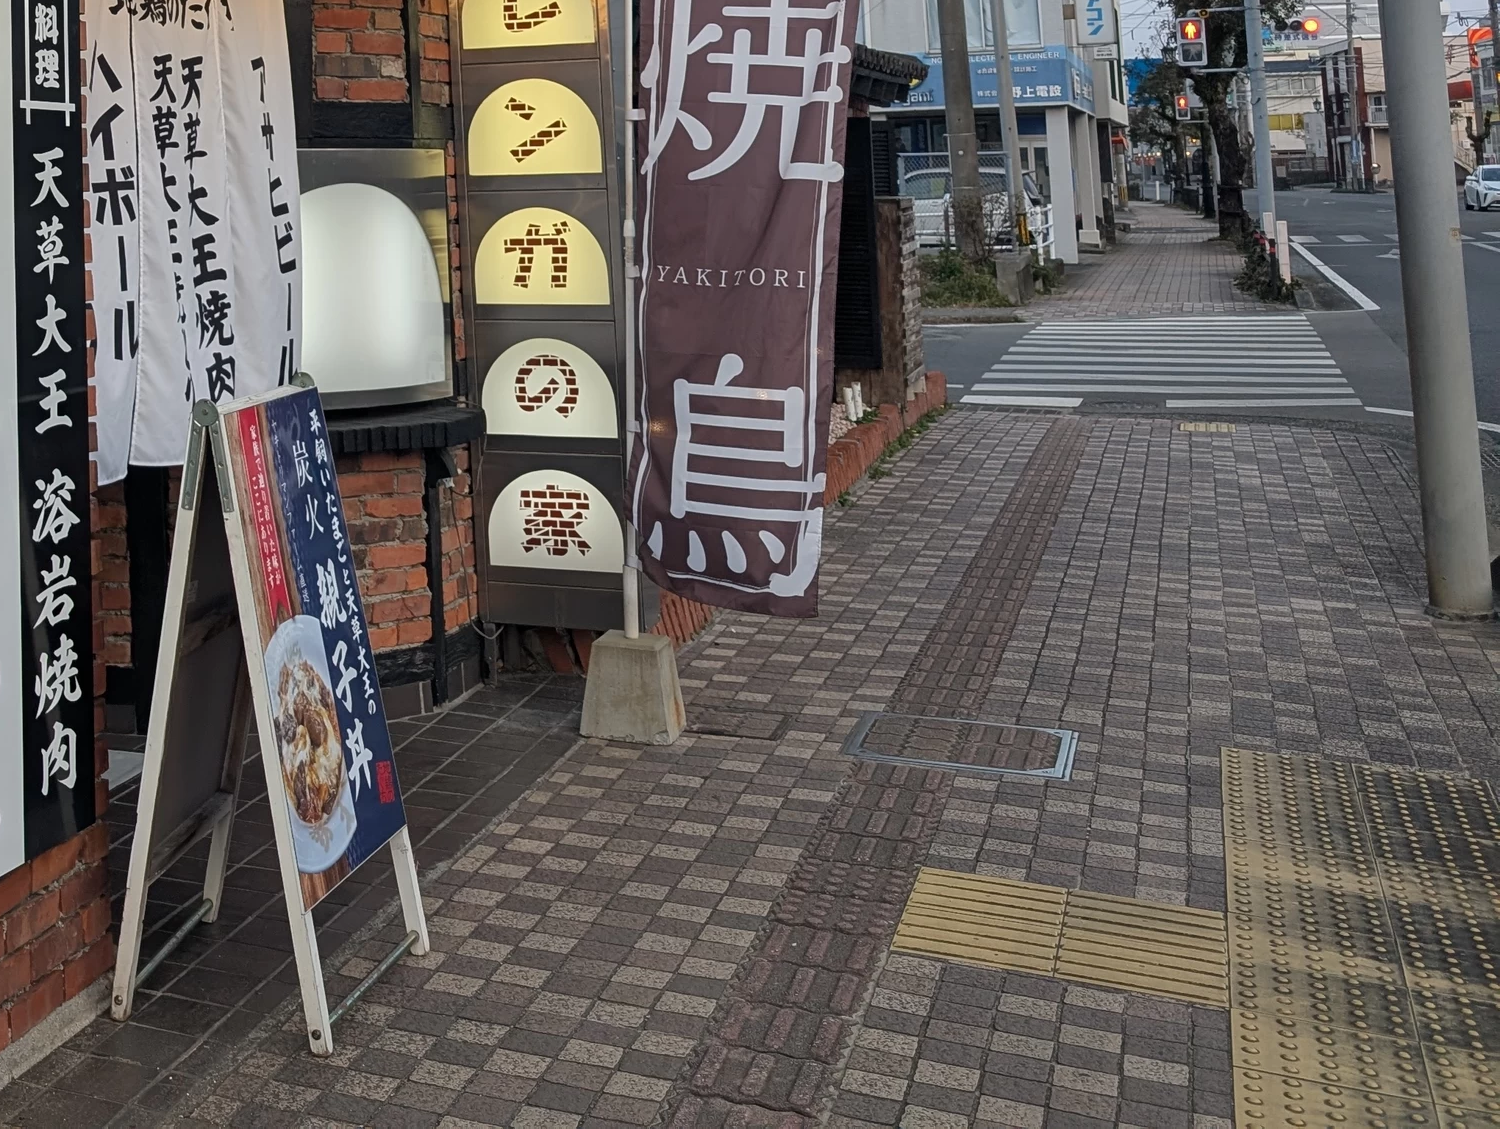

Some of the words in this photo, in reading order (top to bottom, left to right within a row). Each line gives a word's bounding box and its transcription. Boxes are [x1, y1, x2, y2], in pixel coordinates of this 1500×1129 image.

[89, 39, 140, 361] ハイボール
[1018, 51, 1060, 60] ENGINEER
[30, 146, 74, 436] 天草大王
[180, 55, 235, 403] 天草大王焼肉
[655, 264, 807, 289] YAKITORI
[32, 468, 82, 797] 溶岩焼肉
[308, 408, 377, 715] 平飼いたまごと天草大王の
